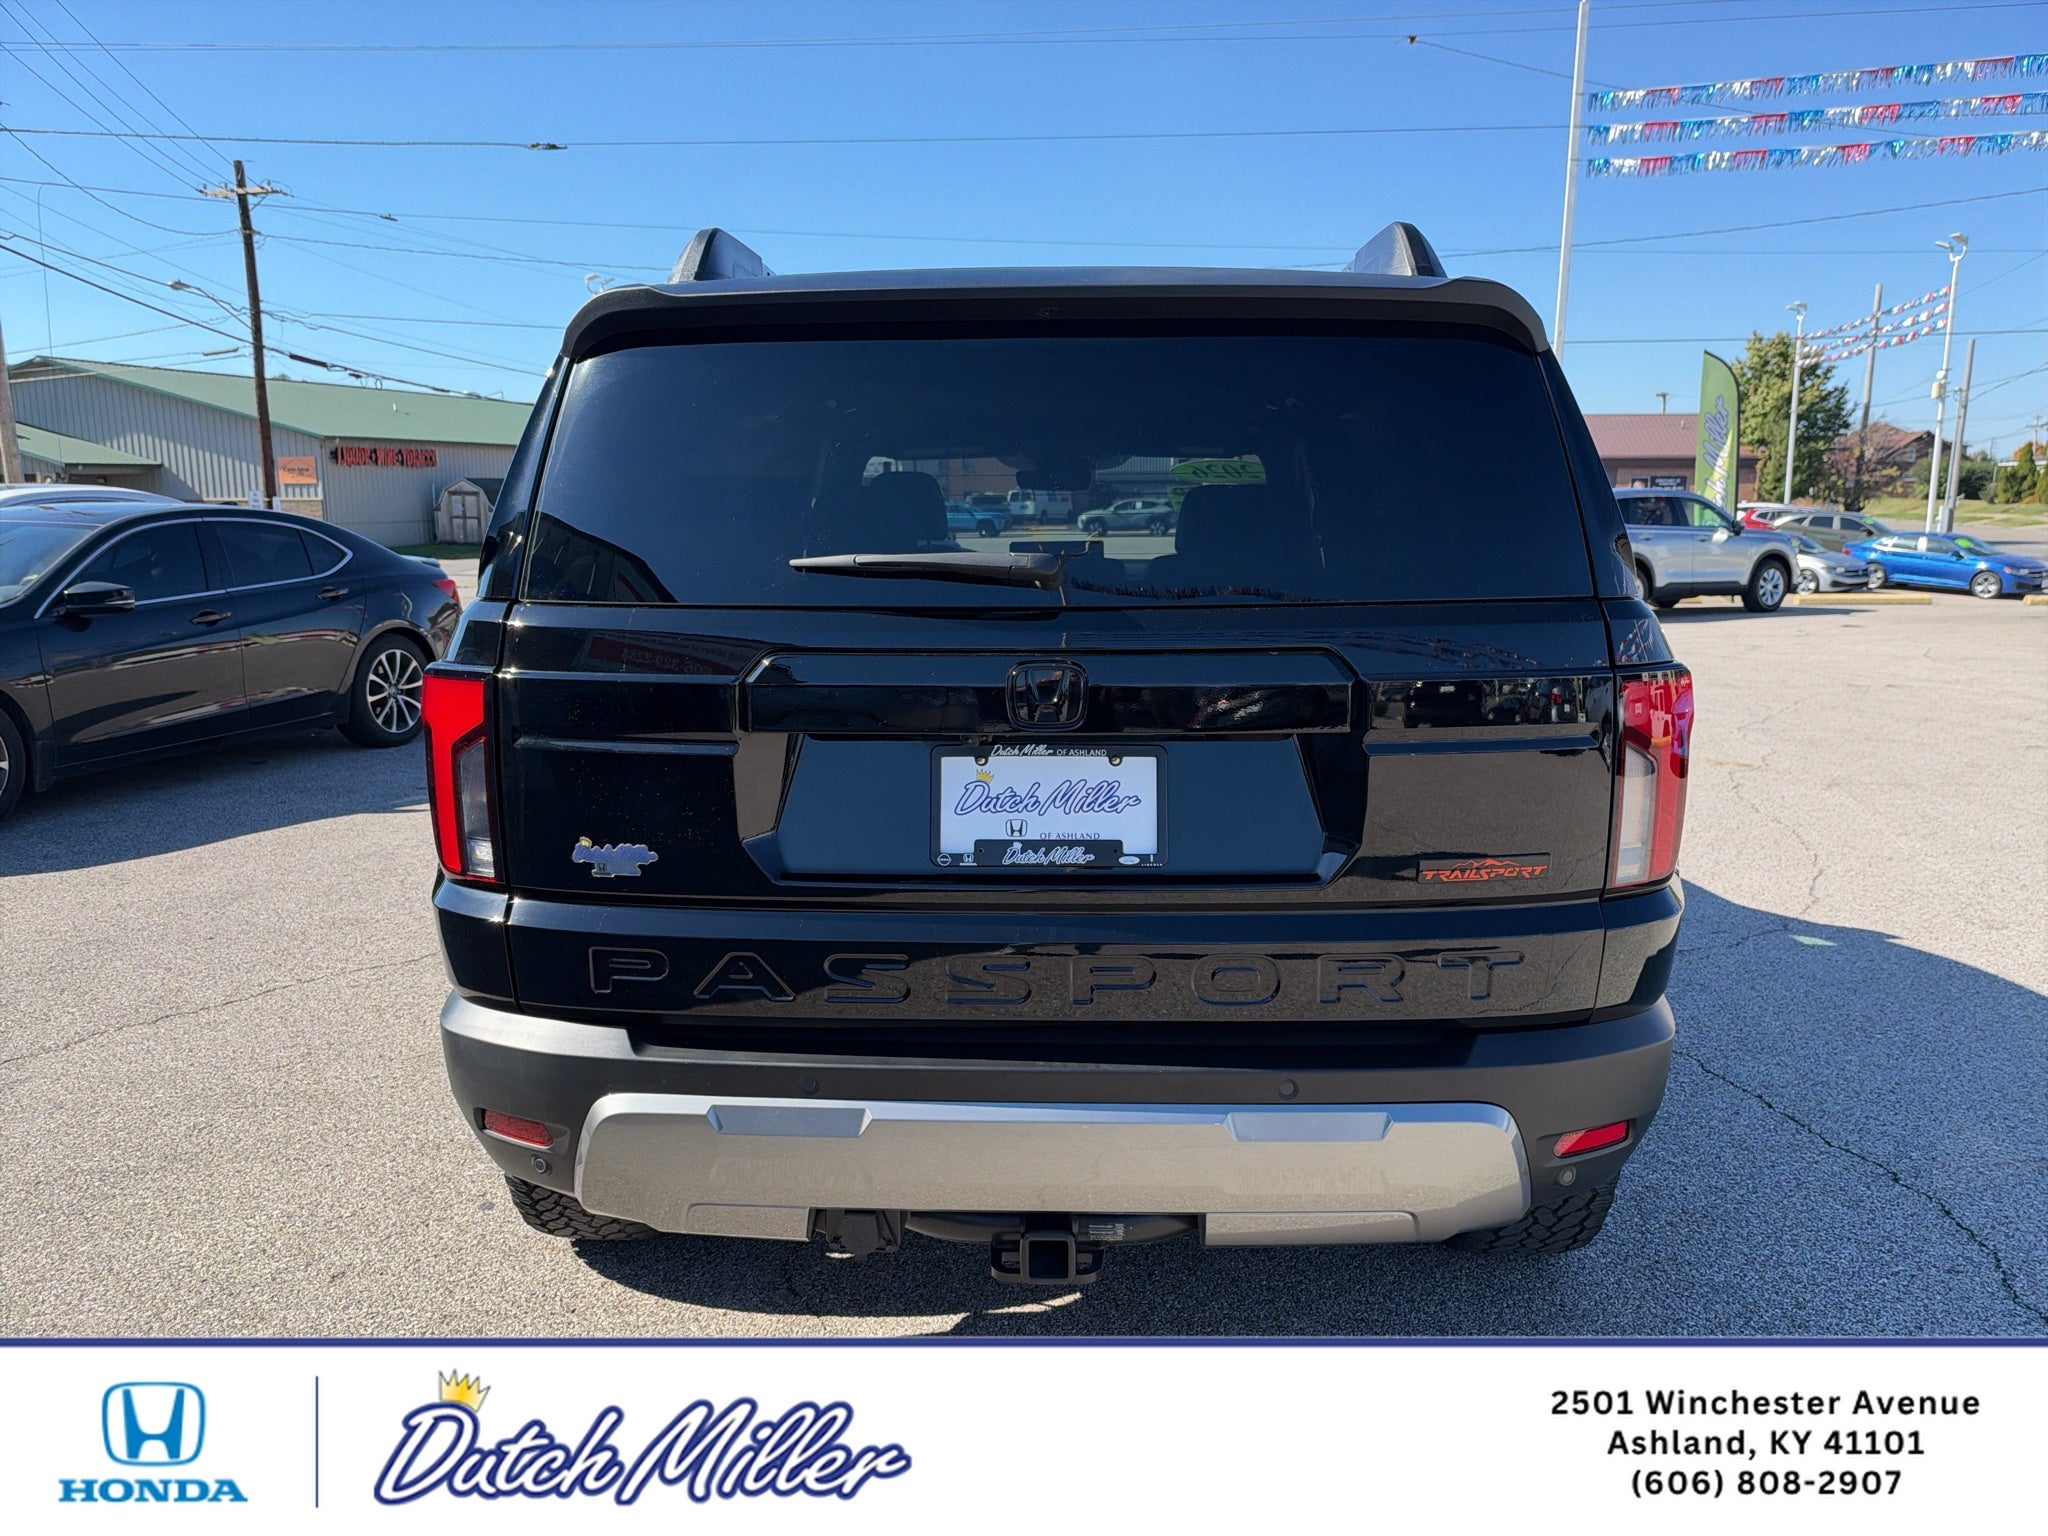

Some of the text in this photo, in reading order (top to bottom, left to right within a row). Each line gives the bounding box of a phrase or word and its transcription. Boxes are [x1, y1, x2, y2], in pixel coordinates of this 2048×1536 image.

[1703, 395, 1729, 478] Miller
[337, 446, 370, 467] LIQUOR
[991, 744, 1107, 757] Dutch Miller OF ASHLAND
[954, 778, 1142, 816] Dutch Miller
[1039, 832, 1100, 840] OF ASHLAND
[1002, 846, 1095, 865] Dutch Miller
[1422, 865, 1547, 882] TRAILSPORT
[588, 946, 1524, 1007] PASSPORT
